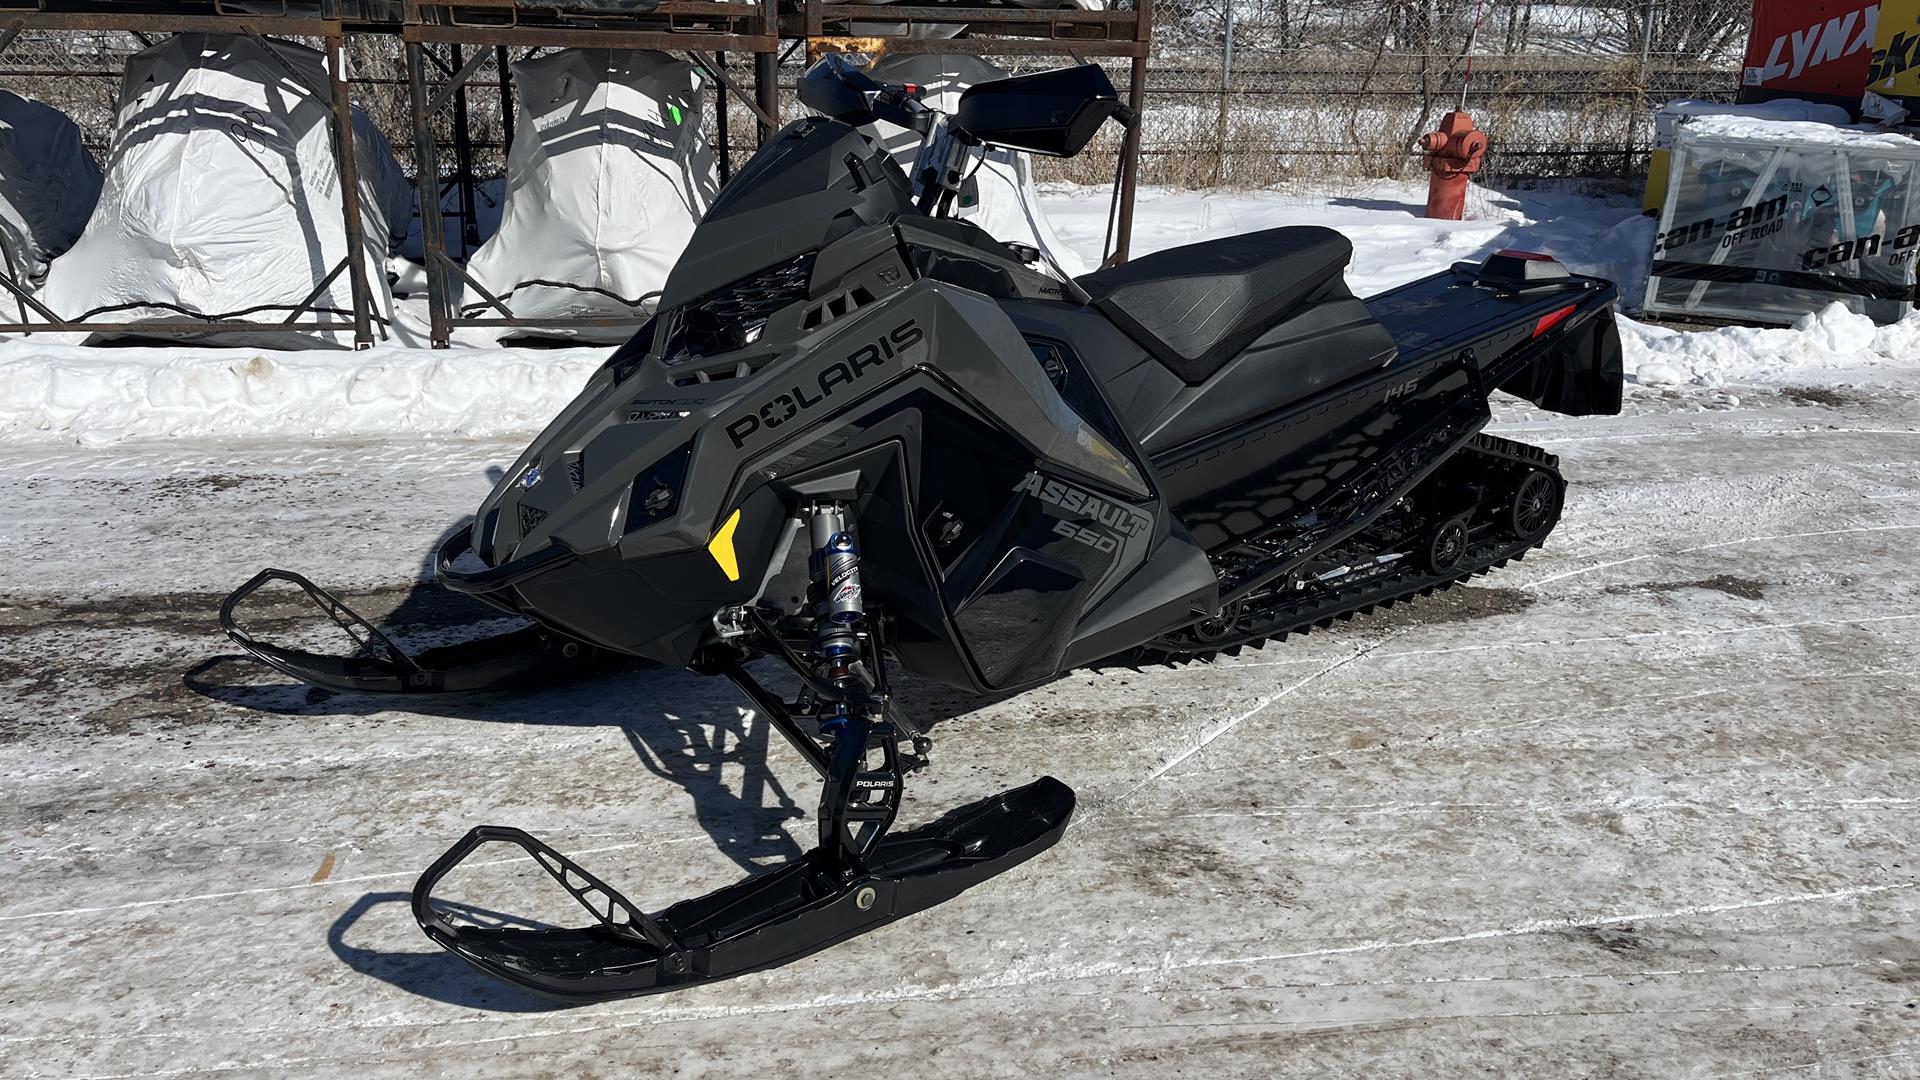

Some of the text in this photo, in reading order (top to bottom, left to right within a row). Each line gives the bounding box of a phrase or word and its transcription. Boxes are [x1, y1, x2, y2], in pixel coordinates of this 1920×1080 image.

[1763, 4, 1878, 81] LYNX
[1722, 218, 1784, 249] OFF ROAD
[1038, 287, 1066, 296] MATR
[725, 318, 924, 450] POLARIS
[1383, 378, 1420, 403] 146
[1011, 472, 1150, 538] ASSAULT
[1052, 519, 1118, 554] 650
[856, 780, 895, 788] POLARIS
